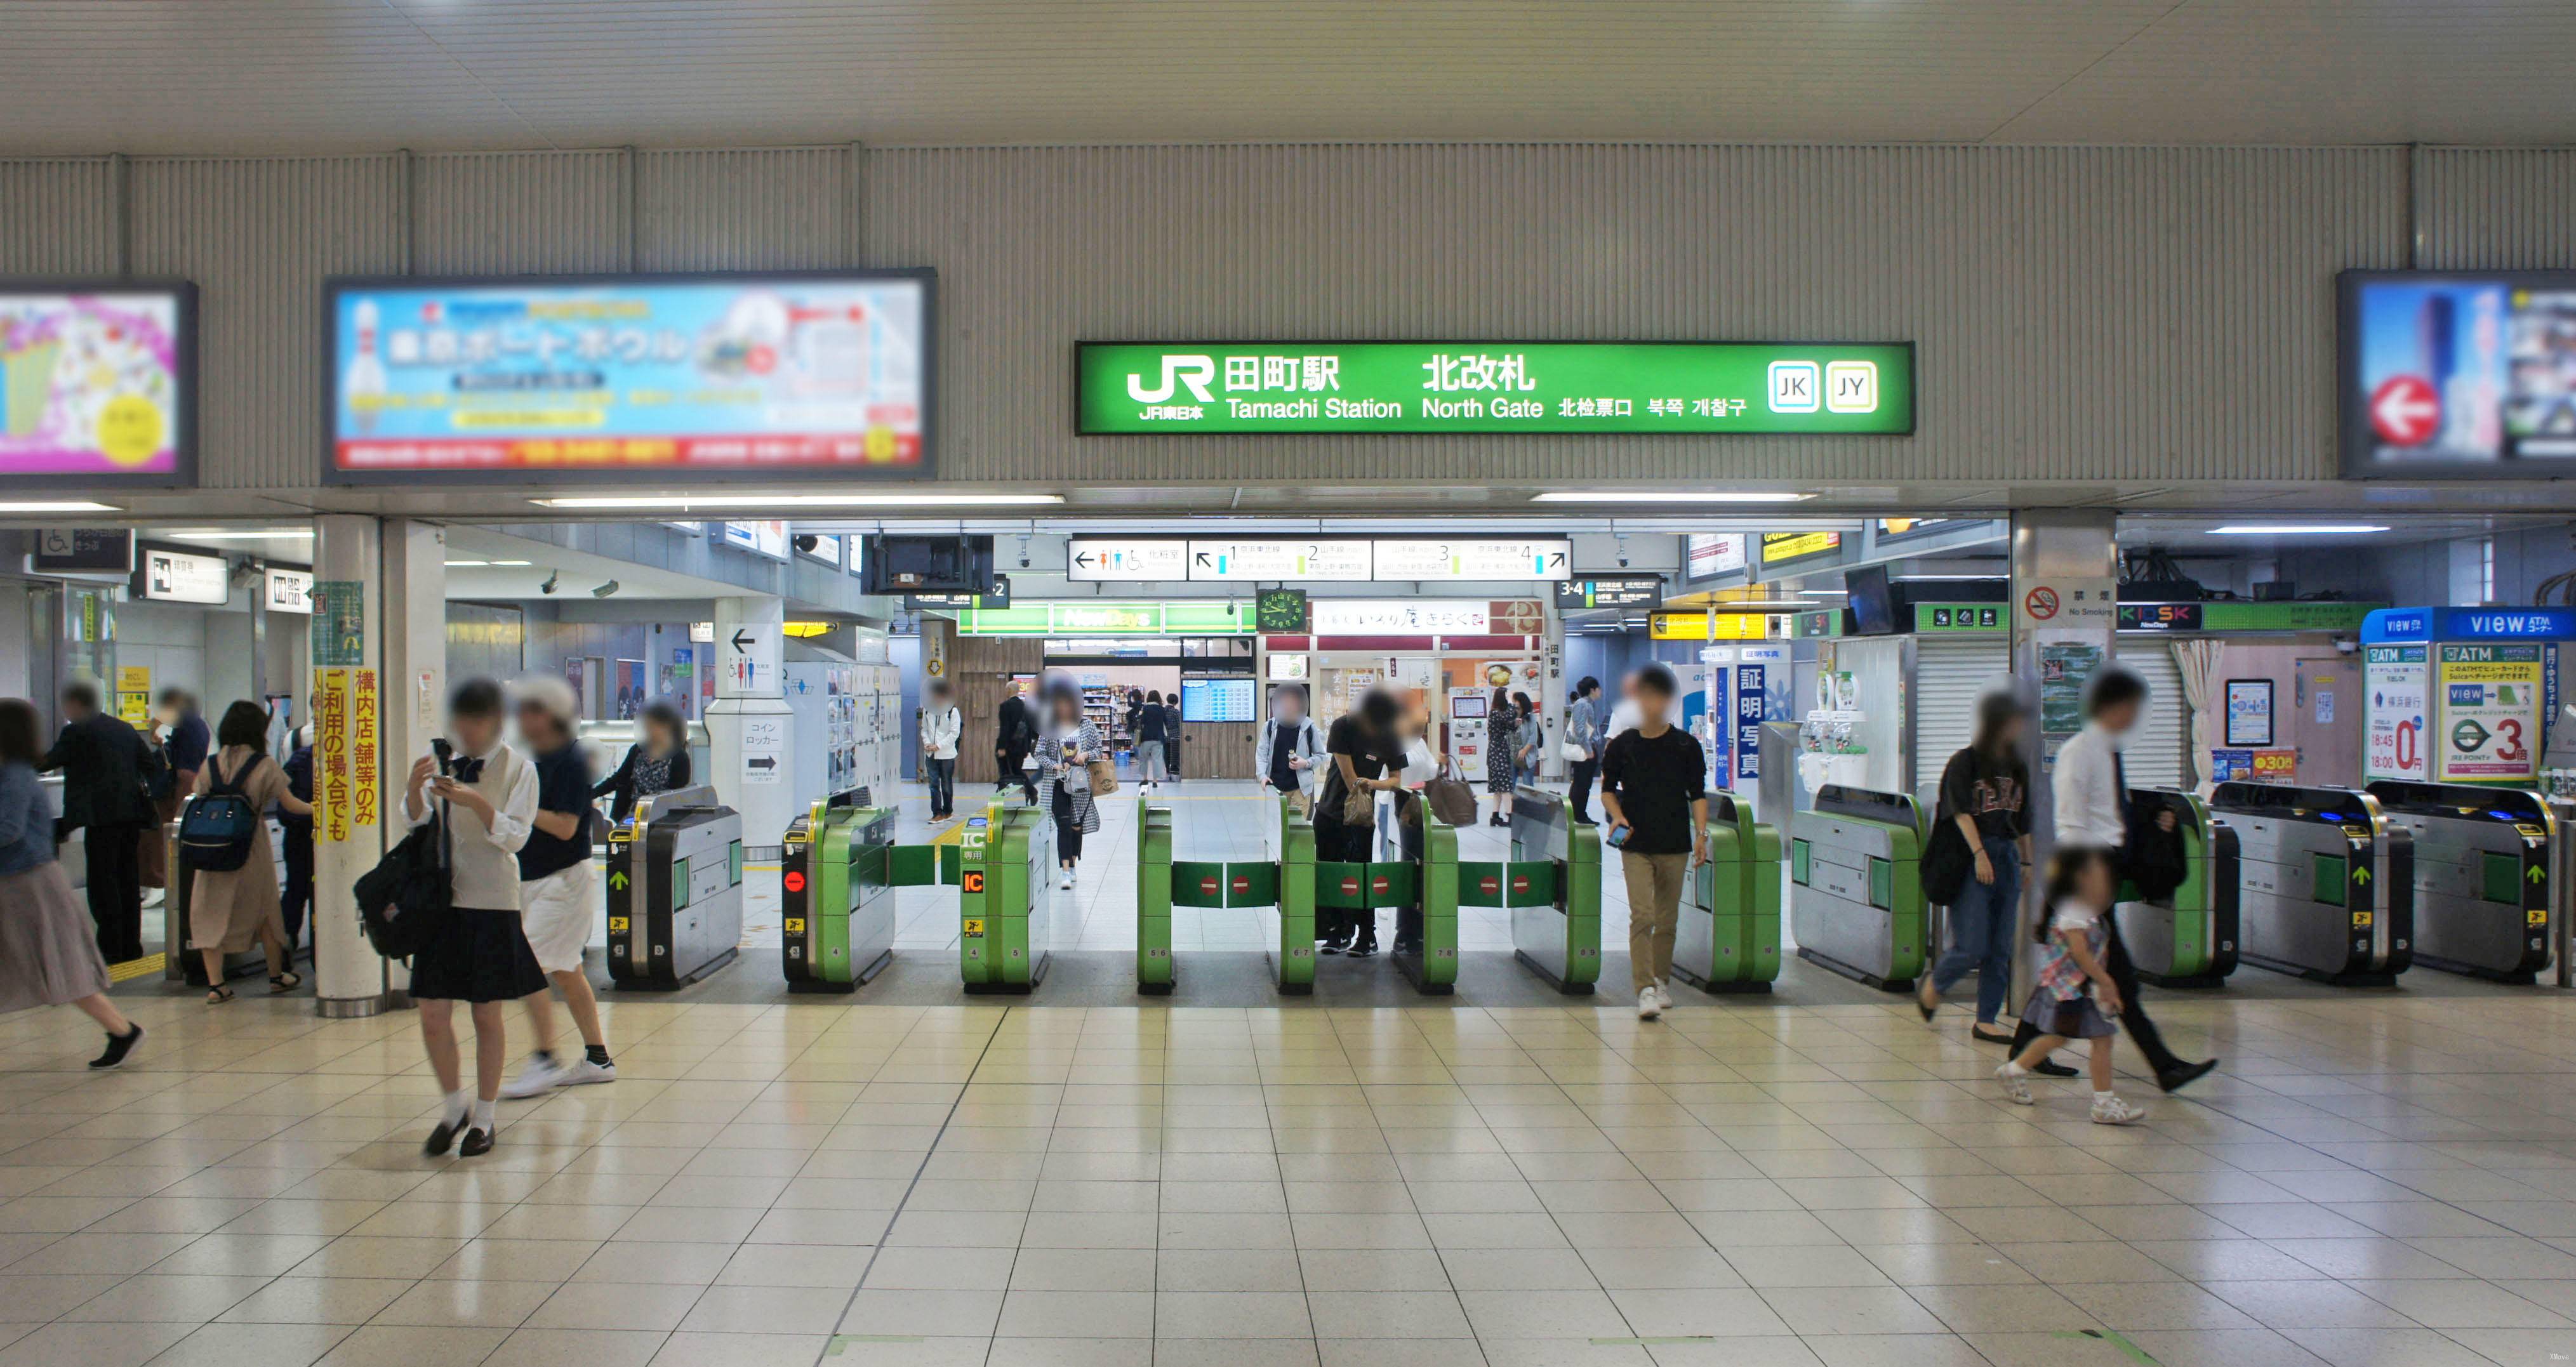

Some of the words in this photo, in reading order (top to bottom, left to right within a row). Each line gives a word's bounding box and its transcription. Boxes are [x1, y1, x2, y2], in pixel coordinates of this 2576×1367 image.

[1127, 355, 1216, 403] JR
[1225, 355, 1340, 392] 田町駅
[1422, 354, 1536, 392] 北改札
[1780, 377, 1807, 396] JK
[1838, 377, 1864, 396] JY
[1139, 406, 1204, 420] JR東日本
[1225, 398, 1318, 419] Tamachi
[1324, 398, 1401, 419] Station
[1422, 398, 1483, 418] North
[1489, 397, 1544, 418] Gate
[1558, 398, 1632, 417] 北检票口
[1647, 398, 1684, 417] 북쪽
[1691, 398, 1747, 417] 개찰구
[1230, 546, 1235, 560] 1
[1308, 545, 1318, 560] 2
[1439, 545, 1449, 561] 3
[1521, 546, 1531, 560] 4
[1063, 608, 1150, 628] NewDays
[2081, 608, 2113, 617] Smoking
[2120, 606, 2189, 620] KIOSK
[2528, 617, 2551, 626] ATM
[2377, 649, 2399, 662] ATM
[2458, 647, 2492, 661] ATM
[752, 723, 776, 732] コイン
[1740, 669, 1762, 775] 証明写真
[354, 670, 376, 825] 構内店舗等のみ
[746, 736, 779, 744] ロッカー
[324, 670, 348, 842] ご利用の場合でも
[2372, 756, 2393, 769] 18:00
[961, 832, 986, 848] IC
[964, 850, 982, 860] 専用
[964, 873, 983, 892] IC
